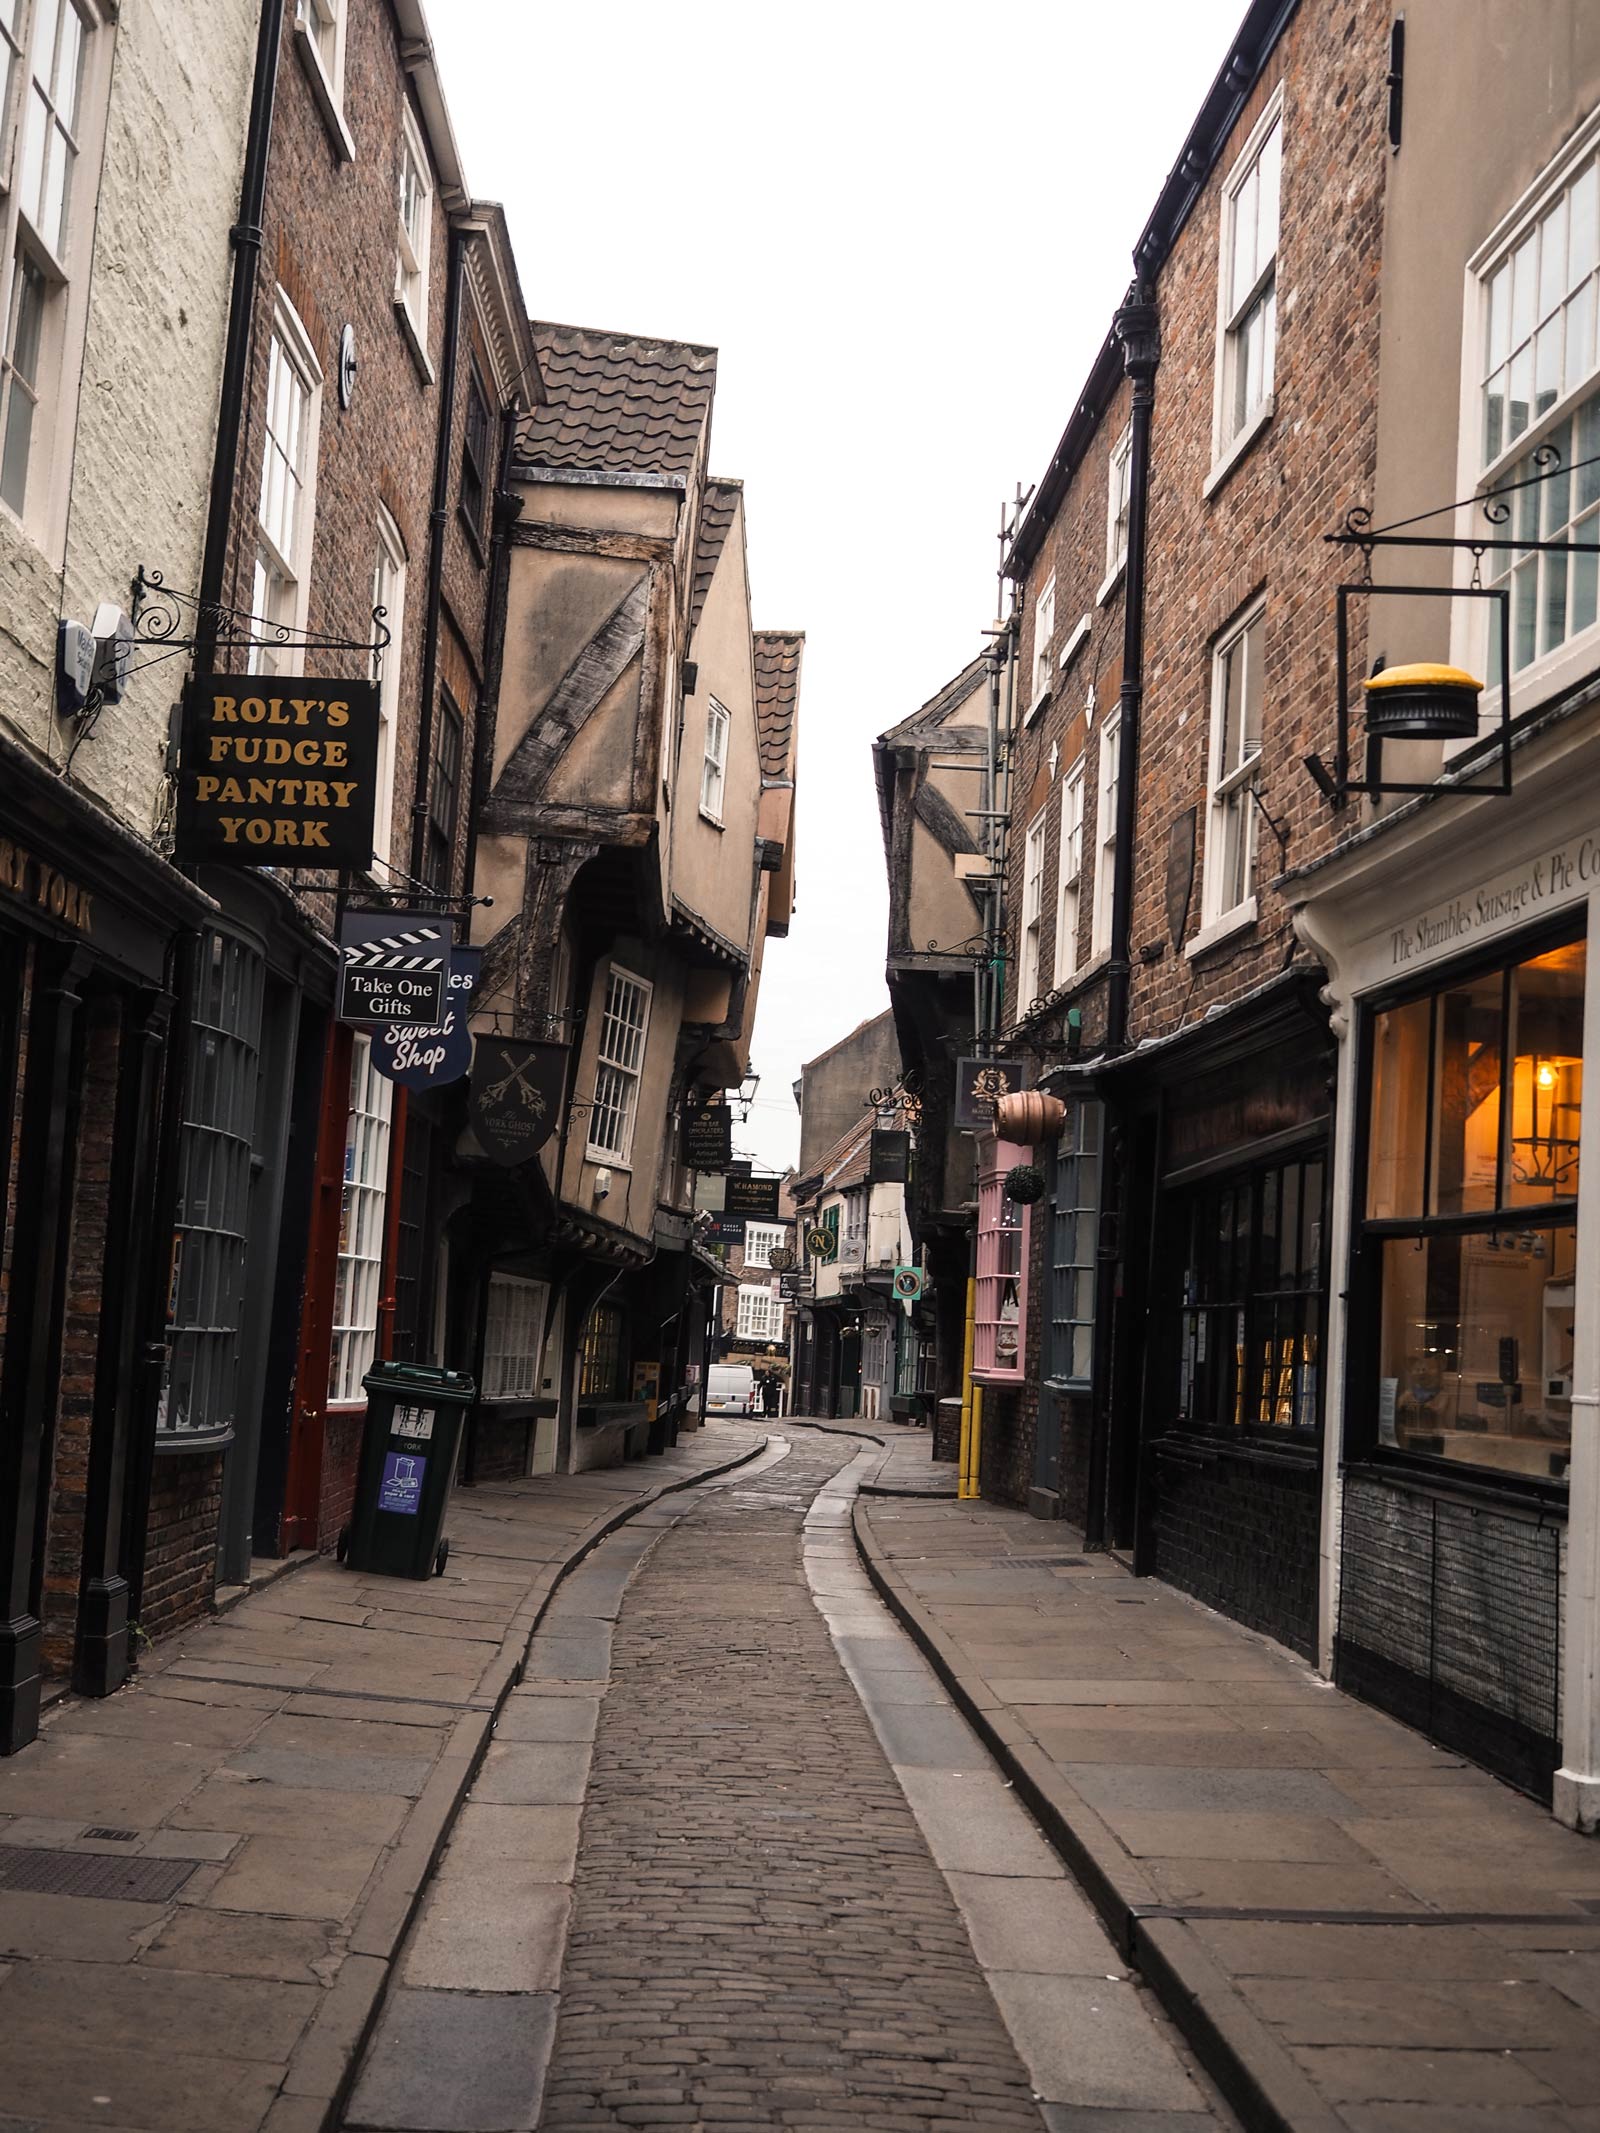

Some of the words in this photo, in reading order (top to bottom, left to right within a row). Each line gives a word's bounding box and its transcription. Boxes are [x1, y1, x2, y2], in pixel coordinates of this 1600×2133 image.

[211, 696, 350, 728] ROLY'S
[208, 736, 349, 767] FUDGE
[195, 776, 358, 808] PANTRY
[218, 817, 332, 847] YORK
[38, 863, 94, 936] YORK
[1391, 929, 1413, 965] The
[1415, 901, 1472, 954] Shambles
[1474, 880, 1529, 927] Sausage
[1530, 860, 1544, 901] &
[1550, 851, 1574, 895] Pie
[351, 976, 393, 995] Take
[398, 978, 433, 997] One
[368, 997, 412, 1016] Gifts
[384, 1010, 456, 1045] Sweet
[391, 1040, 447, 1075] Shop
[508, 1120, 536, 1133] GHOST
[811, 1234, 829, 1251] N
